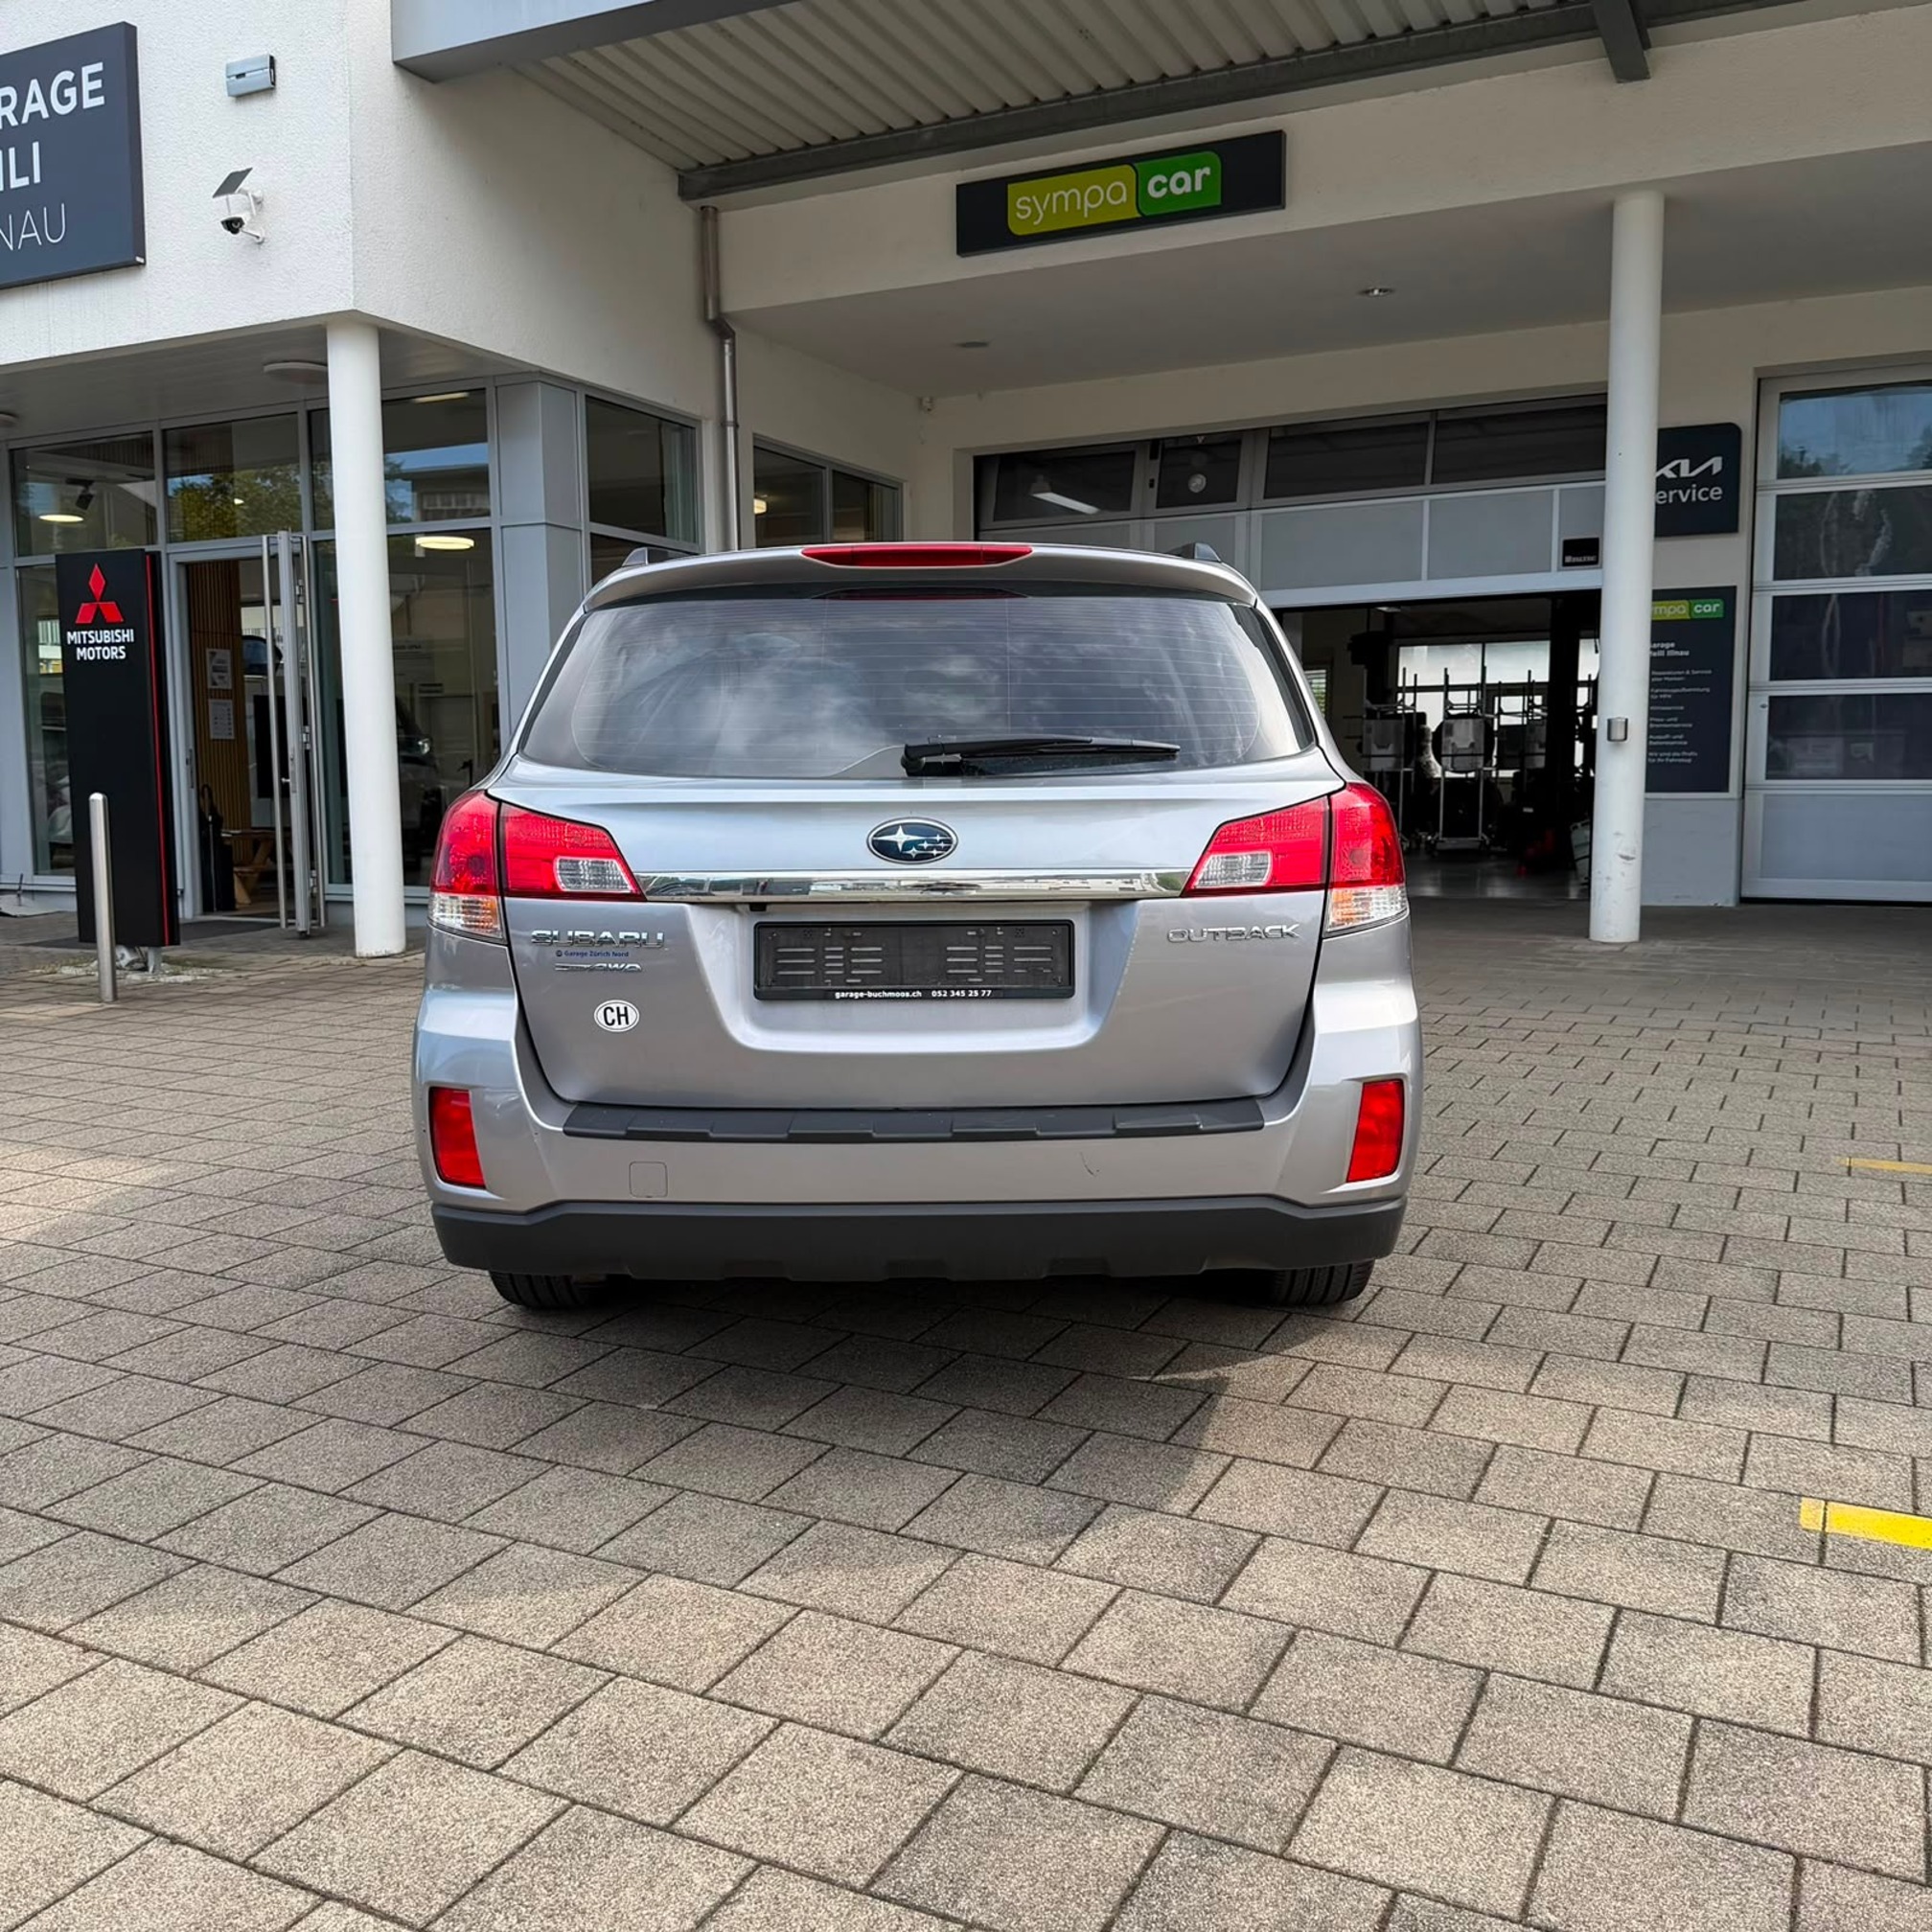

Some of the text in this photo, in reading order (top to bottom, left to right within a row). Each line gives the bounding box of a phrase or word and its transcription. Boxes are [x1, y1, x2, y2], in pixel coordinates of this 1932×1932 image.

[0, 61, 105, 129] RAGE
[1015, 166, 1211, 226] sympa car
[1693, 603, 1720, 613] car
[66, 629, 134, 645] MITSUBISHI
[77, 645, 126, 660] MOTORS
[530, 930, 665, 948] SUBARU
[1167, 924, 1300, 943] OUTBACK
[612, 949, 630, 957] Nord
[835, 989, 992, 1000] garage-buchmoos.ch 052 345 25 77
[603, 1006, 630, 1027] CH
